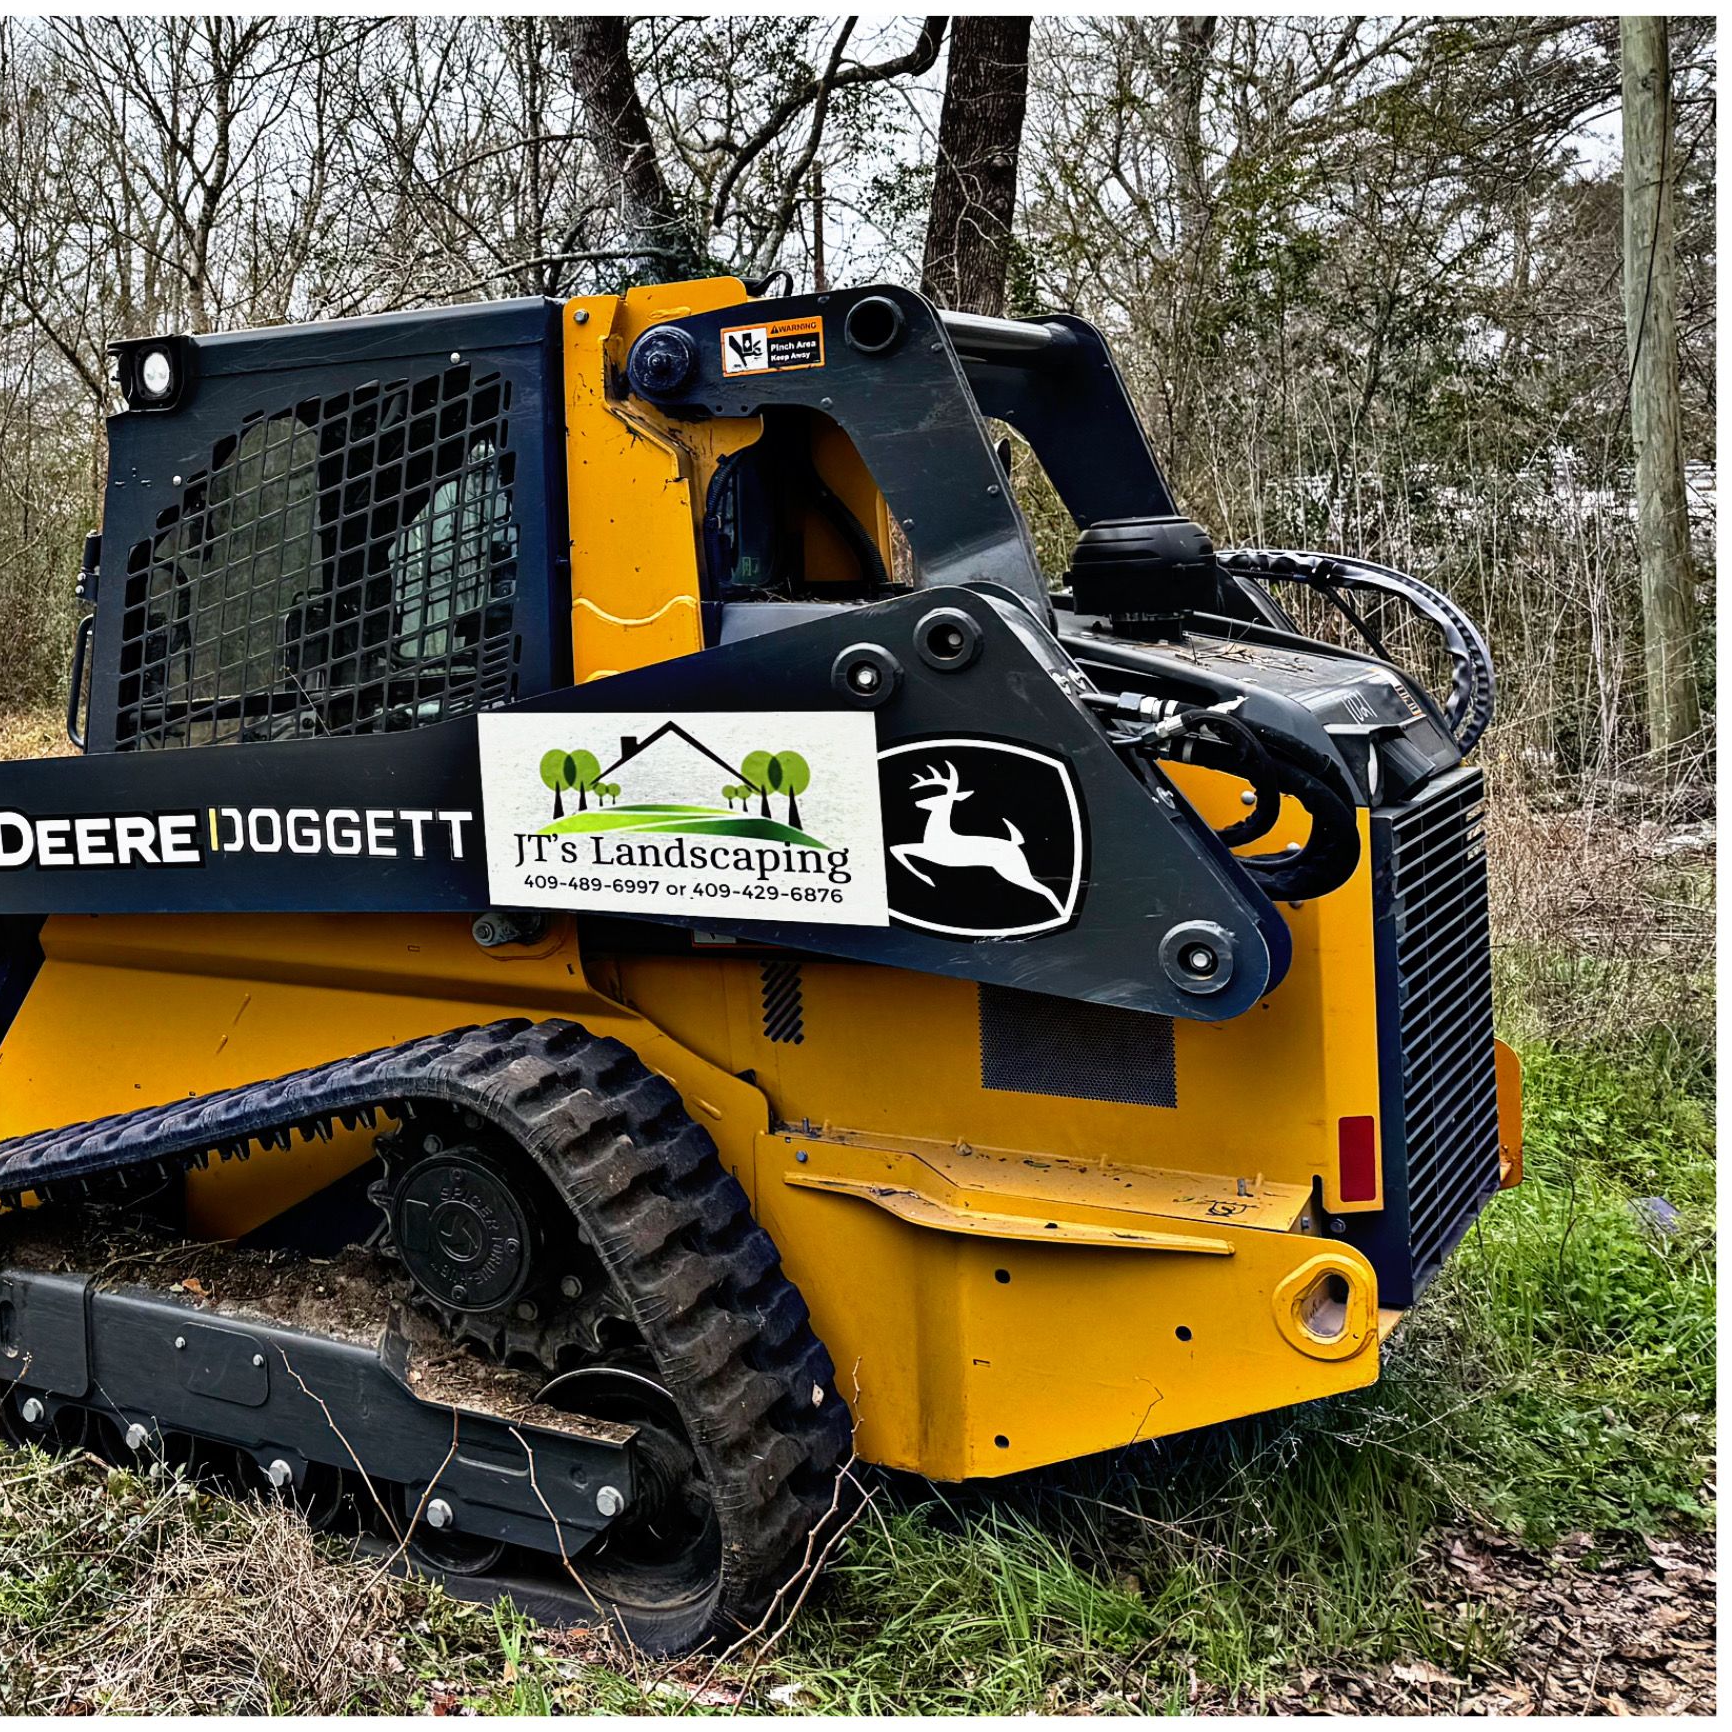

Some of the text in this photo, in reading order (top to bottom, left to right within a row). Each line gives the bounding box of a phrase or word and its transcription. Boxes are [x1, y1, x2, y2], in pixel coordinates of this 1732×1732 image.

[777, 321, 817, 333] WARNING
[770, 340, 817, 352] Pinch Area
[771, 351, 811, 362] Keep Away
[512, 832, 852, 884] JT's Landscaping
[523, 874, 844, 904] 409-489-6997 or 409-429-6876
